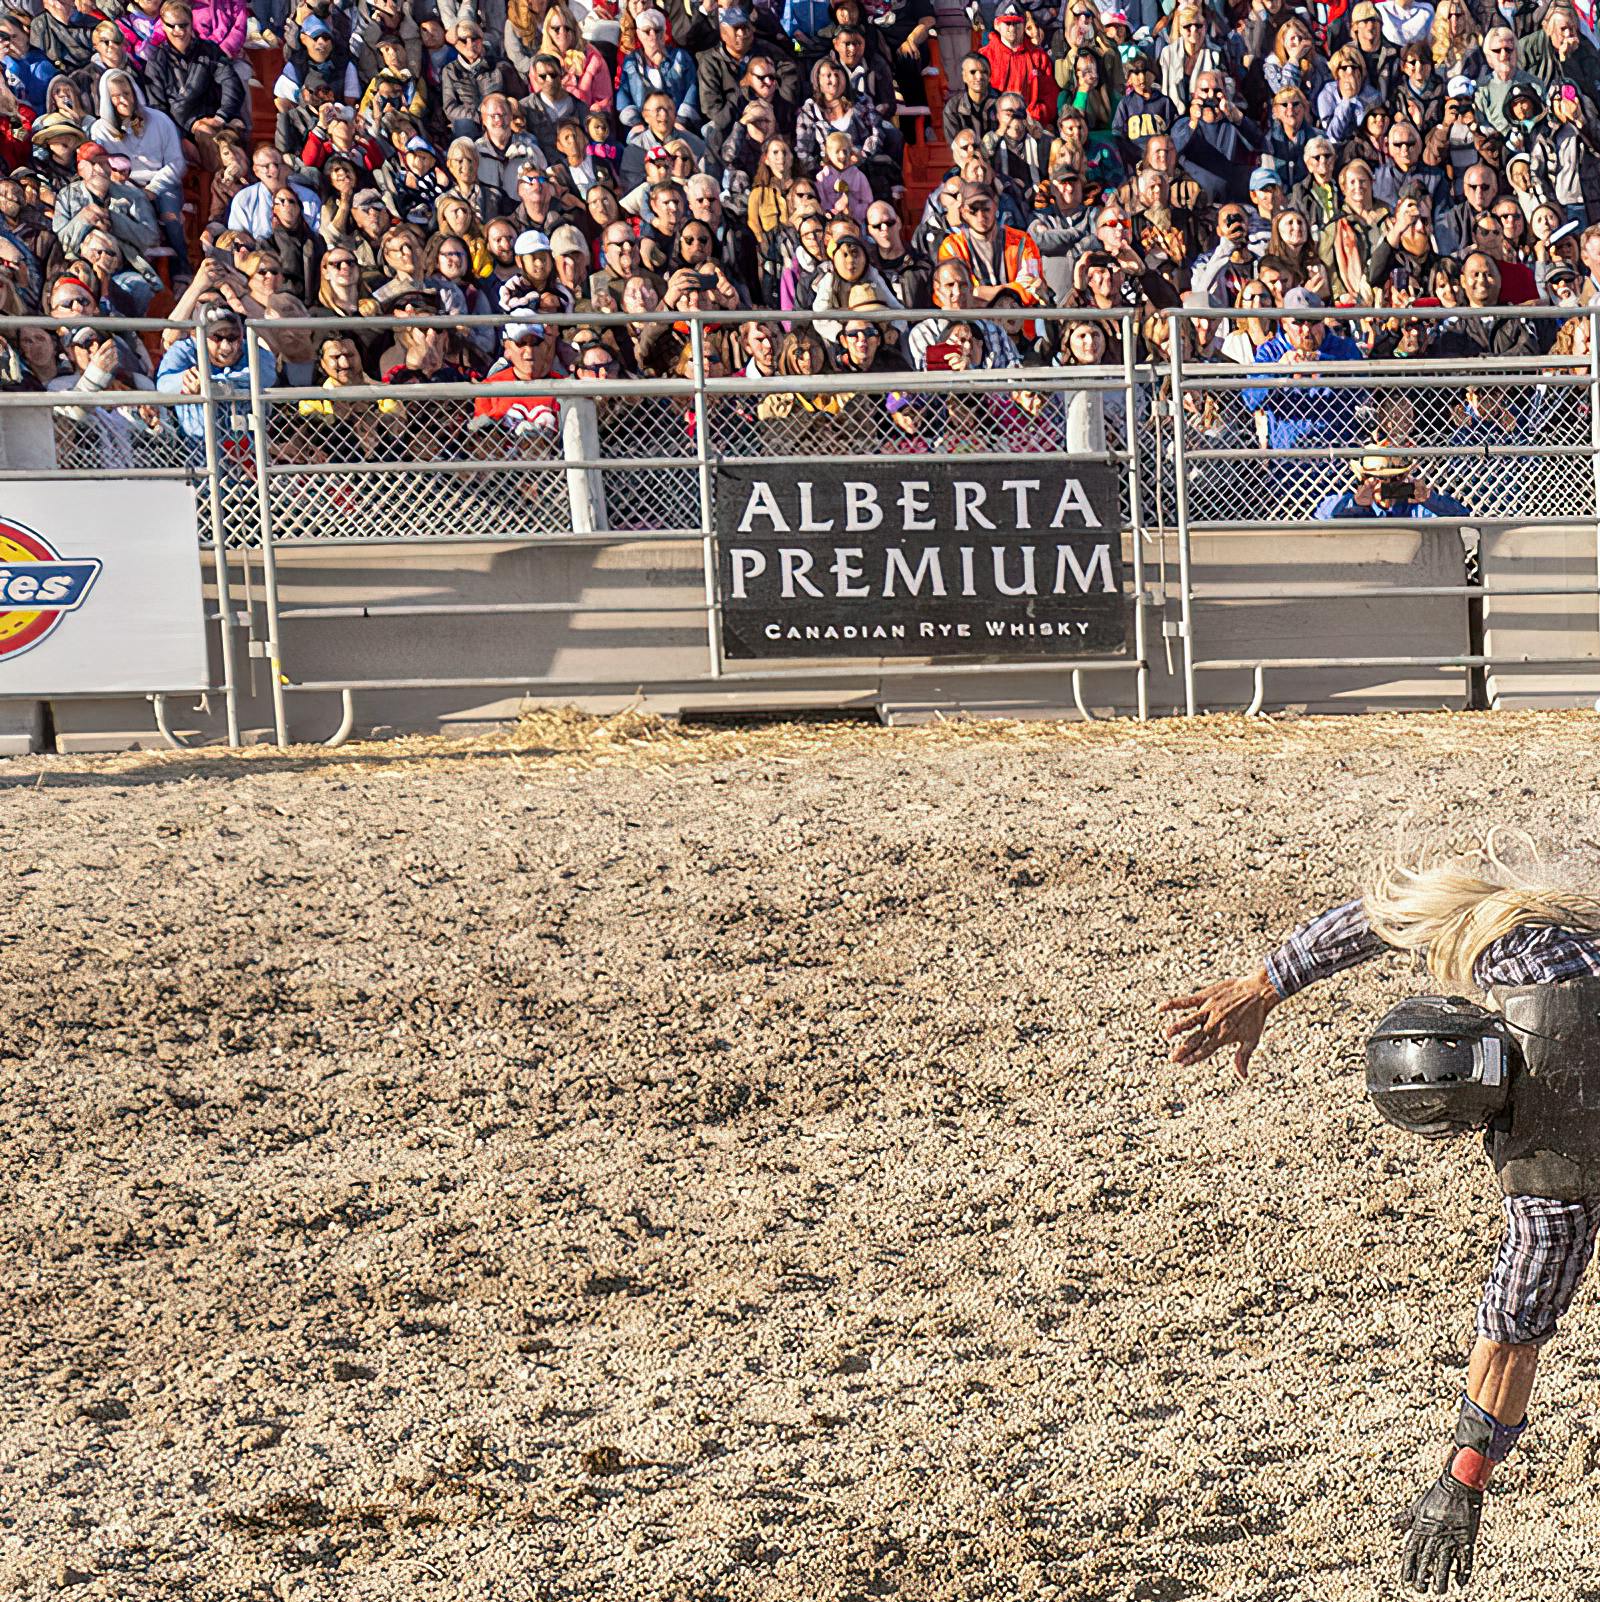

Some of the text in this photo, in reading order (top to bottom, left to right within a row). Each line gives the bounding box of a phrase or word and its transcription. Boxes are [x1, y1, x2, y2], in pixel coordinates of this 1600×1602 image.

[738, 479, 1102, 532] ALBERTA
[730, 544, 1118, 599] PREMIUM
[764, 621, 1090, 640] CANADIAN RYE WHISKY
